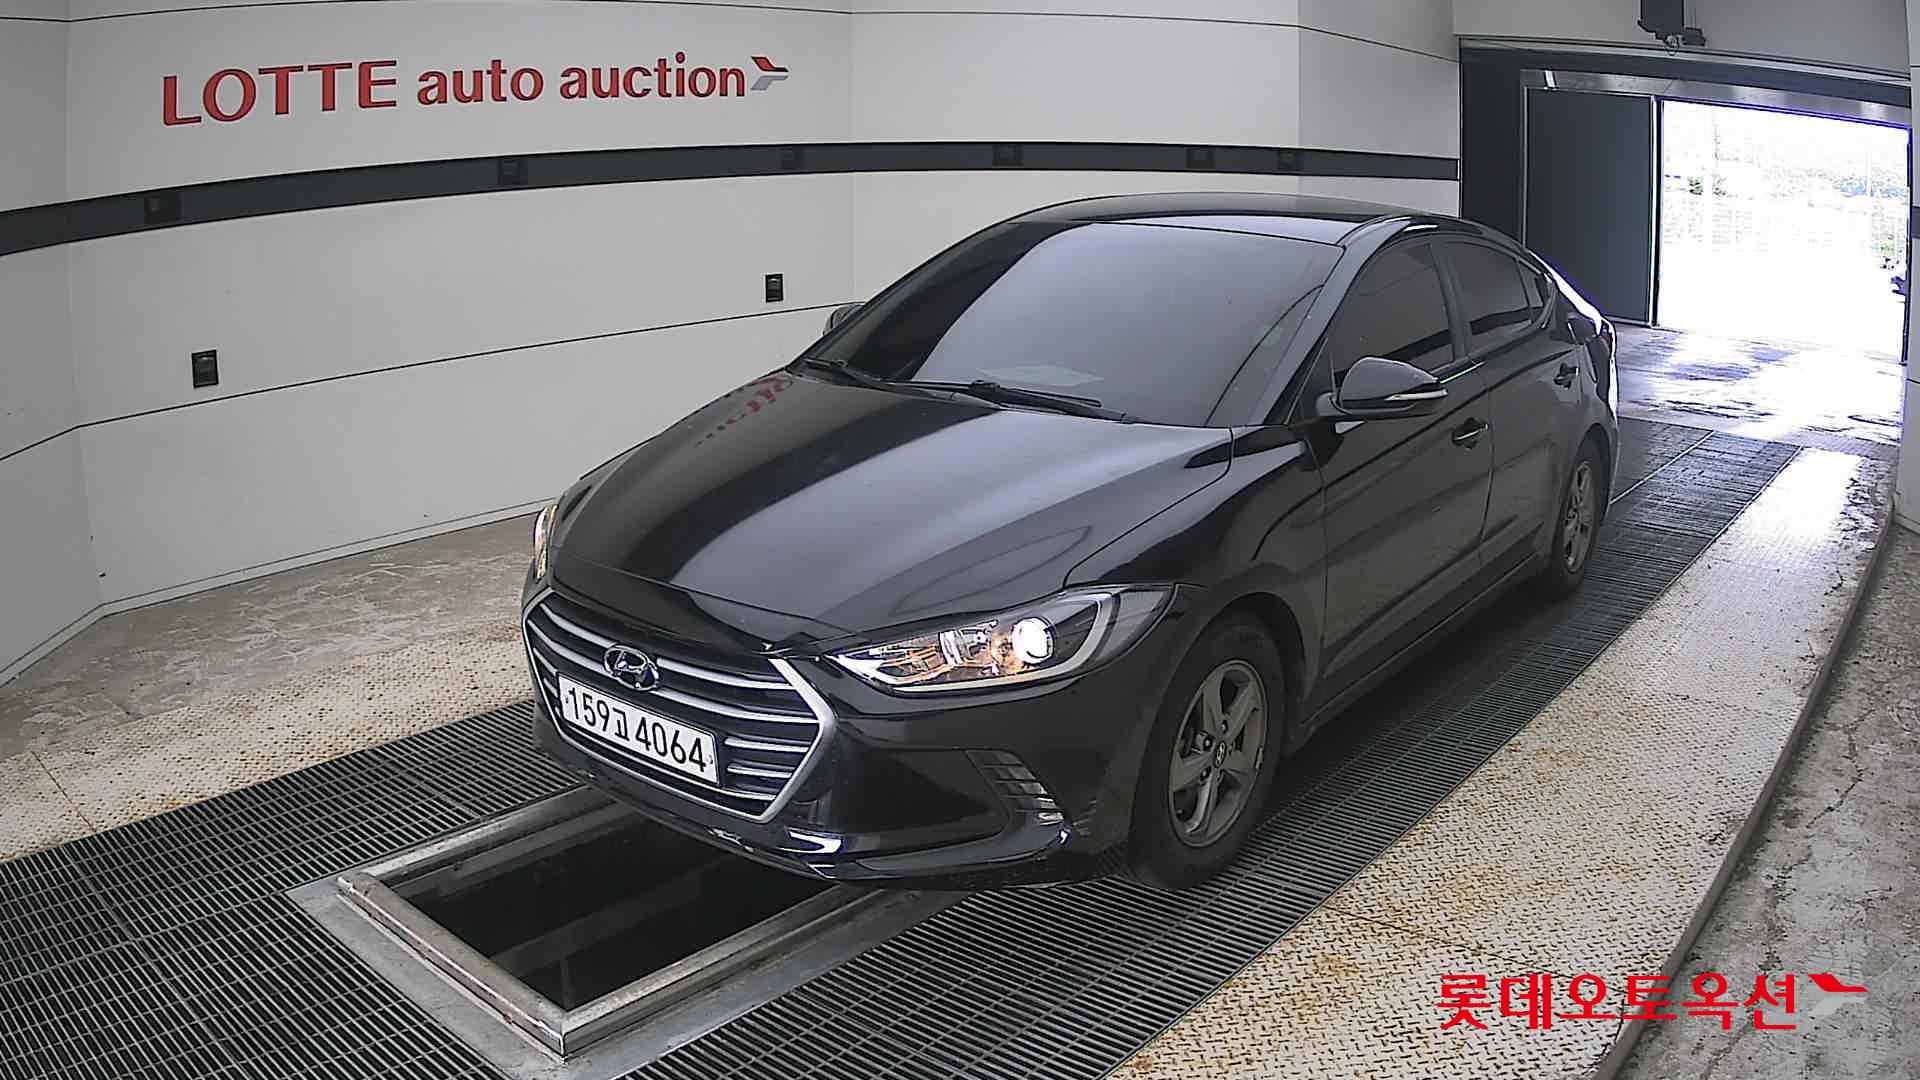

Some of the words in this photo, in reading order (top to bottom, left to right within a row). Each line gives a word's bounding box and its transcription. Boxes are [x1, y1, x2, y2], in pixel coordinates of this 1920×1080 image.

[163, 59, 396, 126] LOTTE
[417, 59, 545, 105] auto
[560, 51, 746, 98] auction
